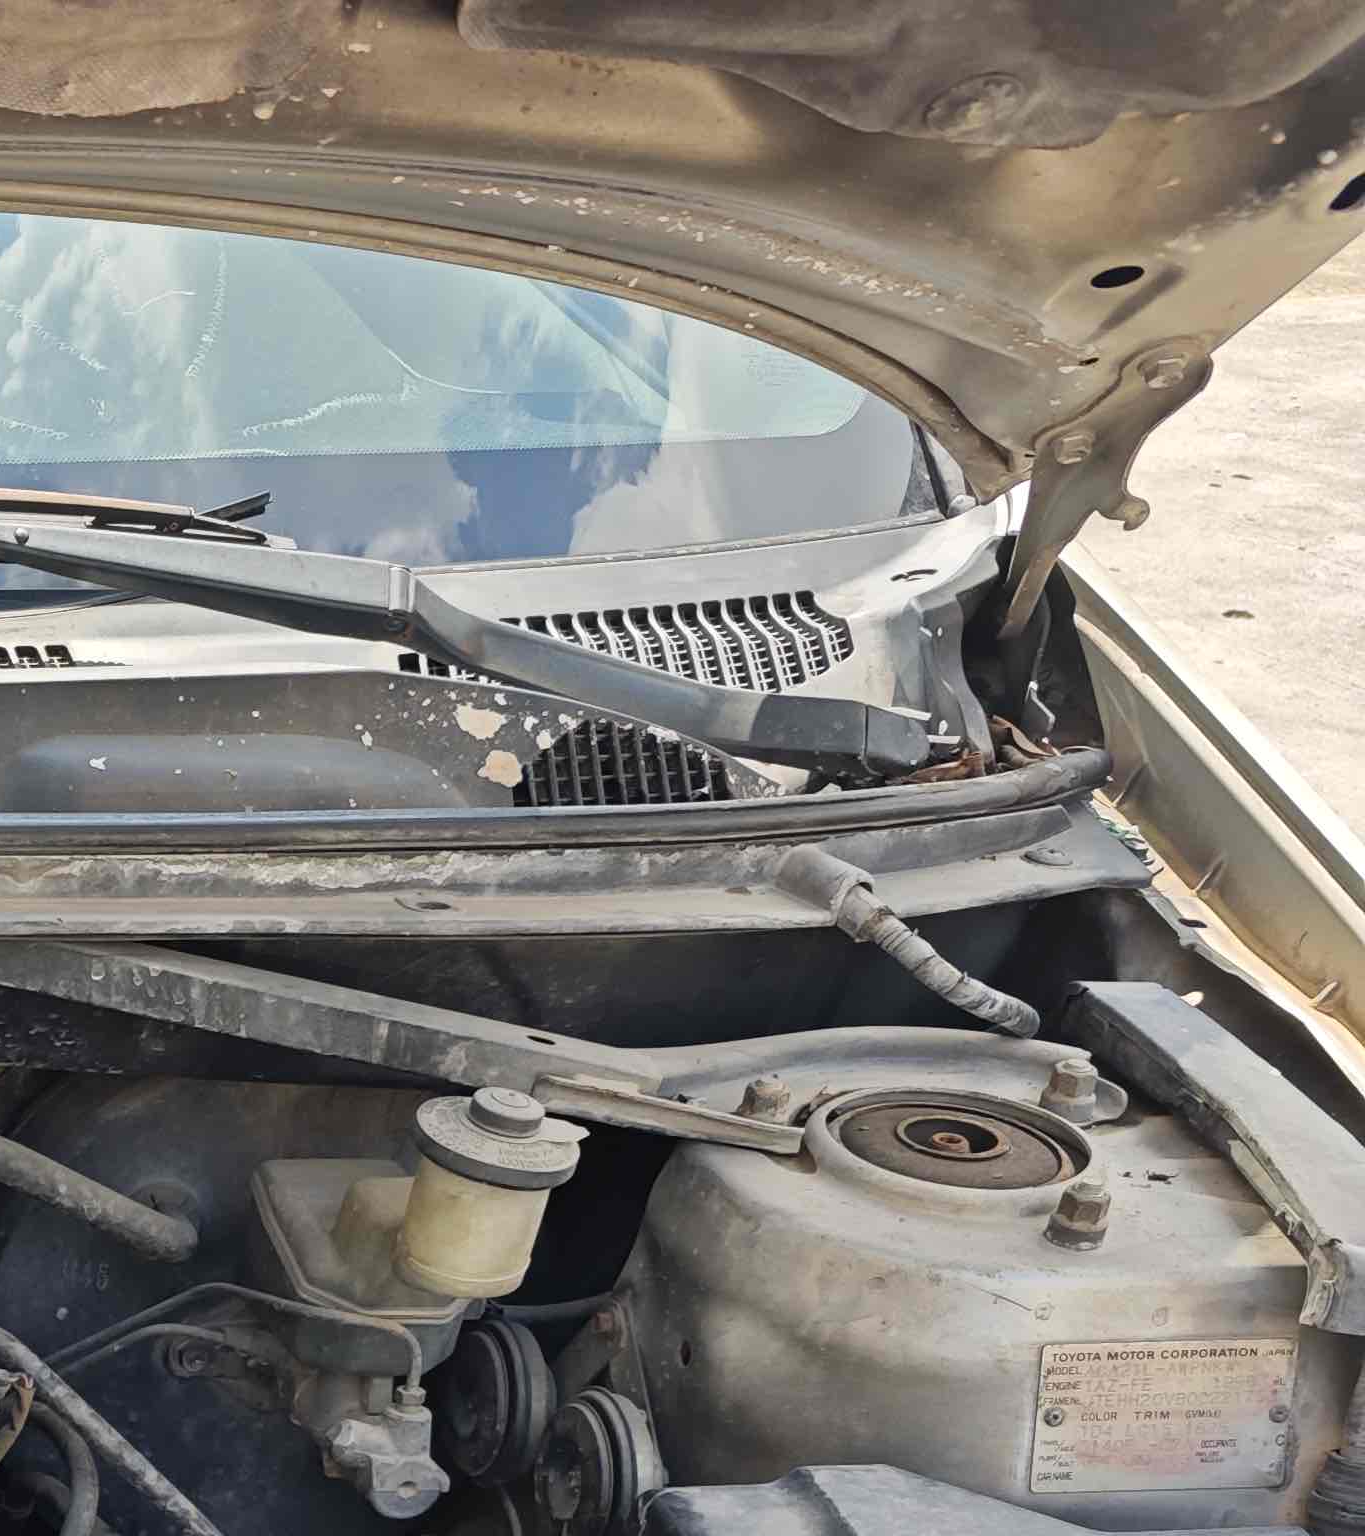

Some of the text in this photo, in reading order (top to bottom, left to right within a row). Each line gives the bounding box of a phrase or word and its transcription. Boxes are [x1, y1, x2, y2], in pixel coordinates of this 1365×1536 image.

[1053, 1352, 1102, 1363] TOYOTA
[1106, 1350, 1155, 1361] MOTOR
[1160, 1347, 1258, 1360] CORPORATION
[1045, 1366, 1082, 1377] MODEL
[1044, 1380, 1082, 1392] ENGINE
[1080, 1411, 1118, 1422] COLOR
[1133, 1410, 1171, 1421] TRIM
